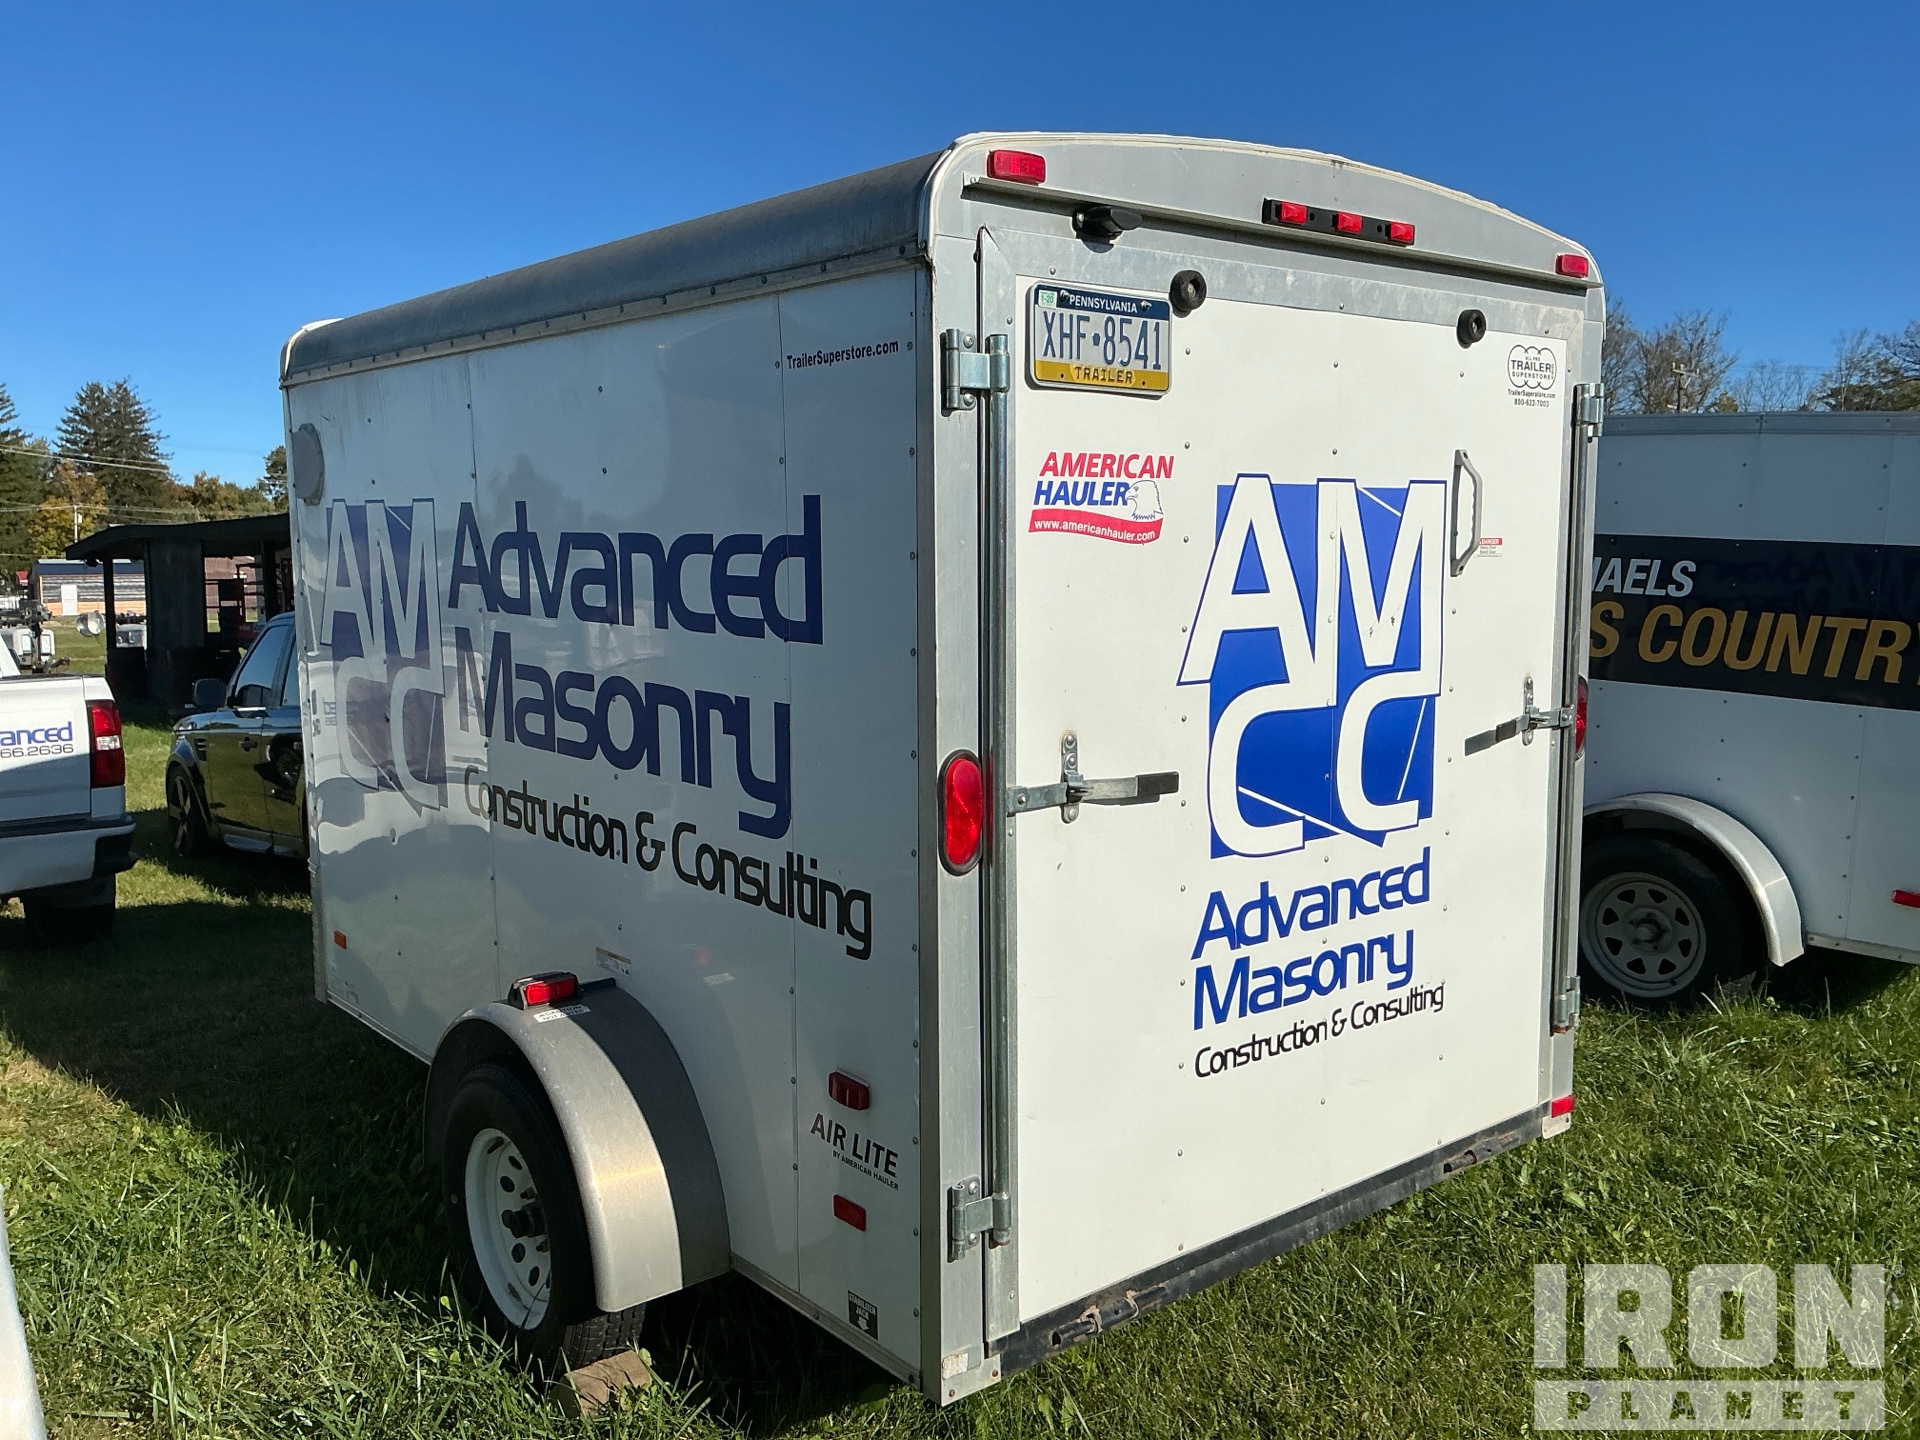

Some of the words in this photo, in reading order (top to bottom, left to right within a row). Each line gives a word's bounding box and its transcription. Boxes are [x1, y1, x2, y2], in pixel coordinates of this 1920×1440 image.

[1069, 294, 1138, 313] PENNSYLVANIA
[786, 340, 899, 369] TrailerSuperstore.com
[1074, 366, 1133, 384] TRAILER
[1510, 360, 1552, 373] TRAILER
[1512, 371, 1551, 381] SUPERSTORE
[1039, 452, 1174, 479] AMERICAN
[1033, 480, 1130, 506] HAULER
[1034, 520, 1156, 542] www.americanhauler.com
[448, 494, 824, 645] Advanced
[1638, 604, 1920, 687] COUNTR
[454, 626, 791, 840] Masonry
[464, 766, 629, 864] Construction
[636, 811, 666, 871] &
[672, 822, 872, 960] Consulting
[1190, 846, 1431, 960] Advanced
[1193, 929, 1414, 1031] Masonry
[1195, 1020, 1328, 1078] Construction
[1331, 1008, 1347, 1037] &
[1350, 984, 1445, 1030] Consulting
[810, 1112, 846, 1151] AIR
[852, 1132, 899, 1178] LITE
[832, 1150, 841, 1160] BY
[841, 1155, 872, 1177] AMERICAN
[873, 1171, 899, 1191] HAULER
